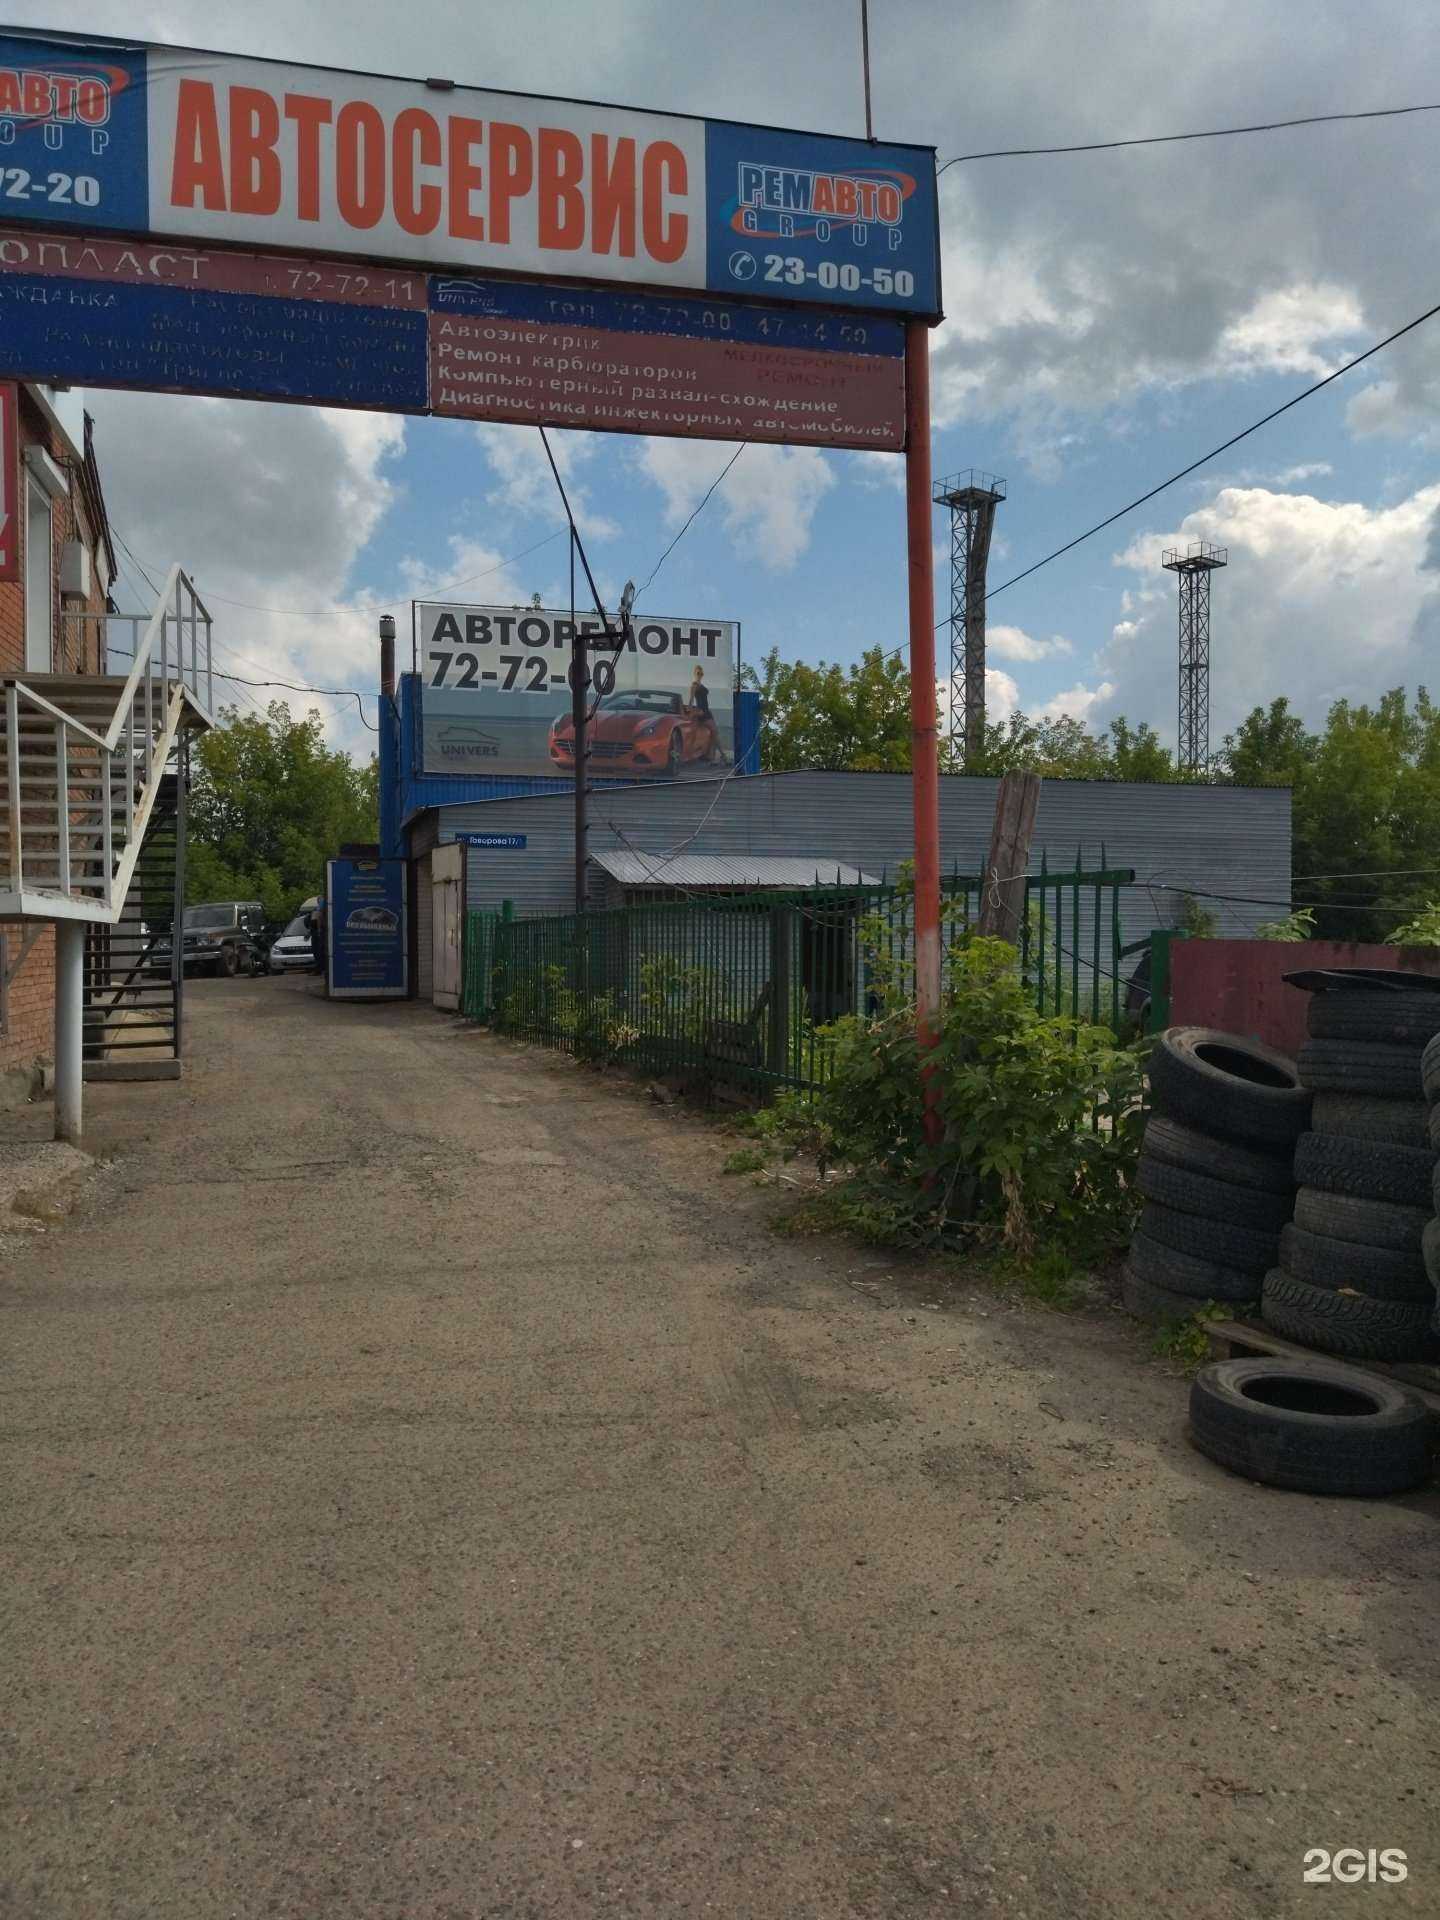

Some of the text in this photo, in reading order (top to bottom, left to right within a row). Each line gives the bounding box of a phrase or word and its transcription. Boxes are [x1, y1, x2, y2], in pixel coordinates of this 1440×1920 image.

[0, 168, 100, 207] 2-20
[170, 78, 689, 264] АВТОСЕРВИС
[738, 162, 903, 226] РЕМАВТО
[742, 209, 903, 250] GROUP
[288, 269, 414, 300] 72-72-11
[764, 254, 914, 297] 23-00-50
[438, 342, 521, 366] Ремонт
[441, 745, 498, 756] UNIVERS
